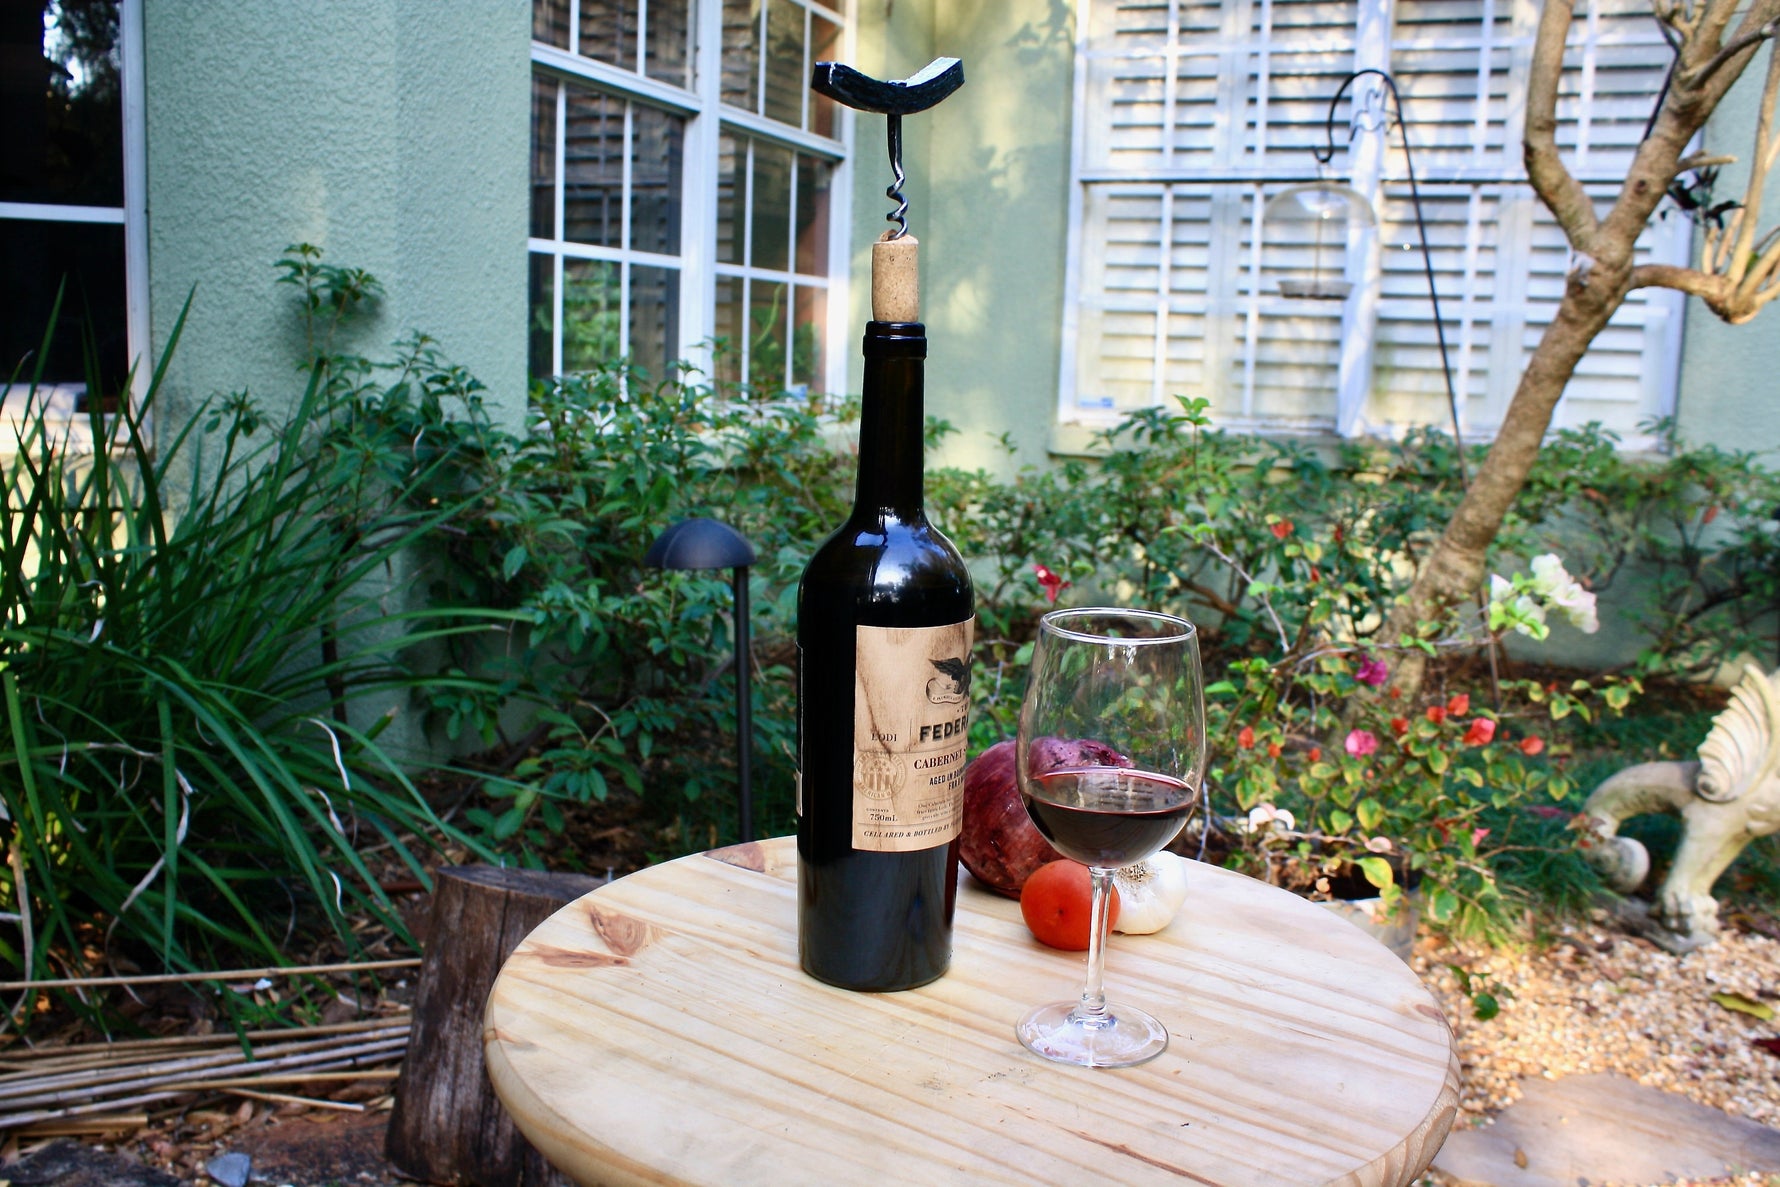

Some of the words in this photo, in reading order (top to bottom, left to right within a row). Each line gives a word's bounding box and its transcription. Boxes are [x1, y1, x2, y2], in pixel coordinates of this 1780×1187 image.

[871, 733, 897, 742] LODI
[913, 748, 962, 770] CABERNET
[929, 774, 946, 786] AGED
[870, 813, 898, 822] 750mL
[863, 830, 904, 839] CELLARED
[913, 826, 943, 838] BOTTLED
